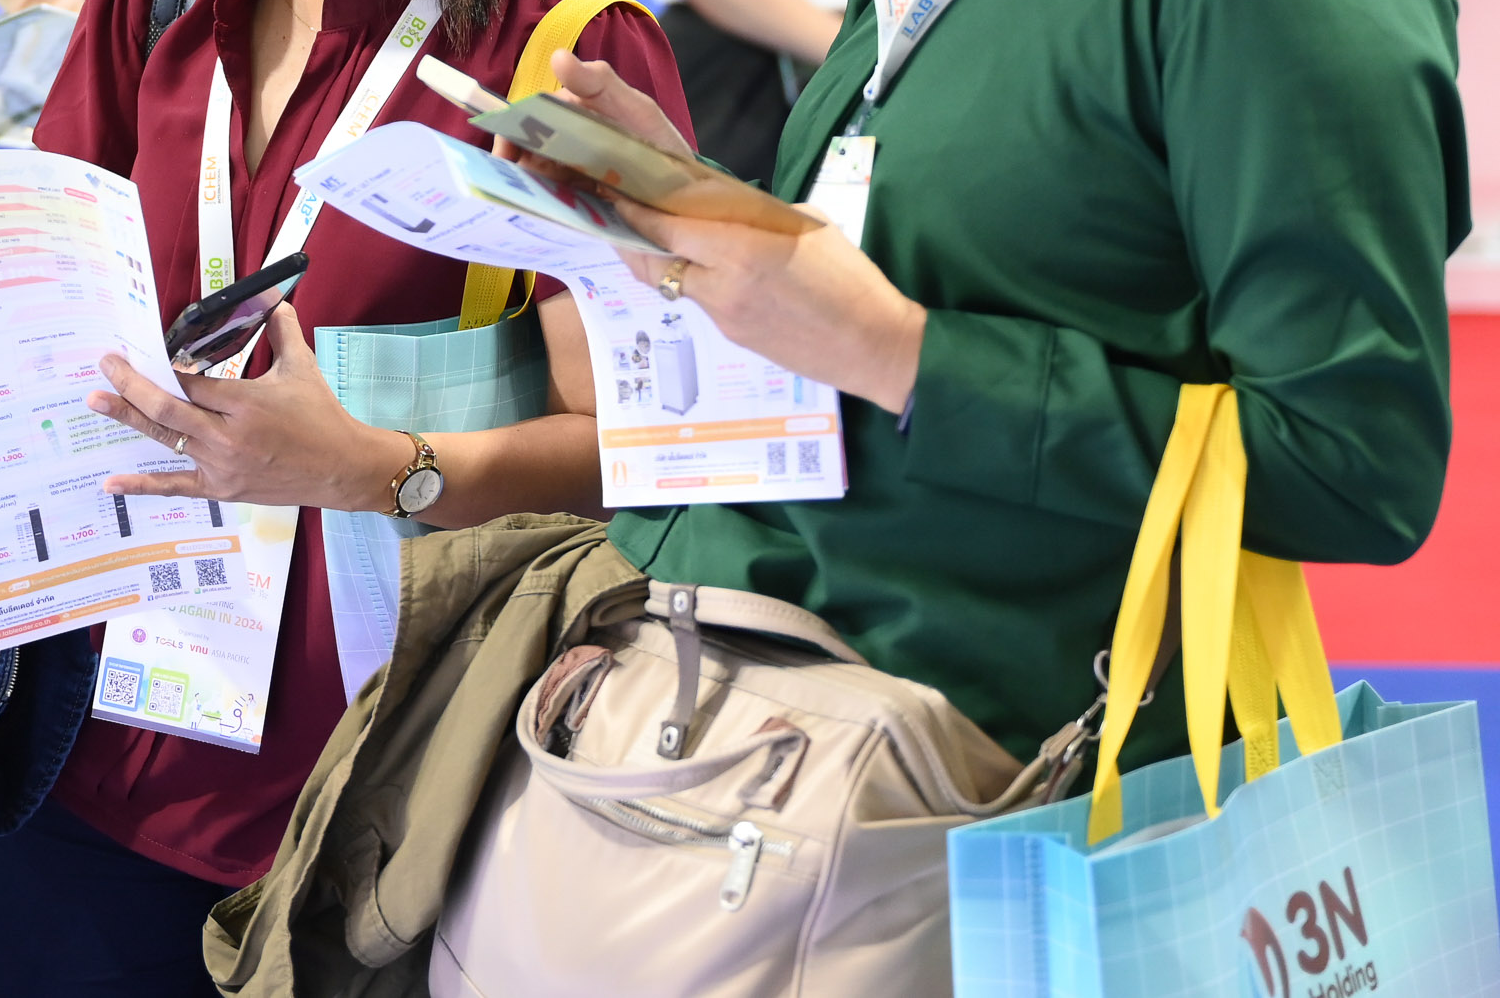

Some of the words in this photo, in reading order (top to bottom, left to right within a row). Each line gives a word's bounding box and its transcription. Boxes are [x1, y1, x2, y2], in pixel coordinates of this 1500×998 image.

[400, 16, 427, 48] BIO
[204, 156, 217, 201] CHEM
[205, 257, 224, 290] BIO
[162, 511, 190, 521] 1,700.-
[71, 529, 99, 540] 1,700.-
[36, 595, 55, 605] จำกัด
[179, 605, 216, 621] AGAIN
[219, 612, 232, 624] IN
[235, 615, 263, 632] 2024
[190, 644, 209, 655] vnu
[211, 650, 226, 659] ASIA
[227, 653, 250, 665] PACIFIC
[1286, 866, 1368, 975] 3N
